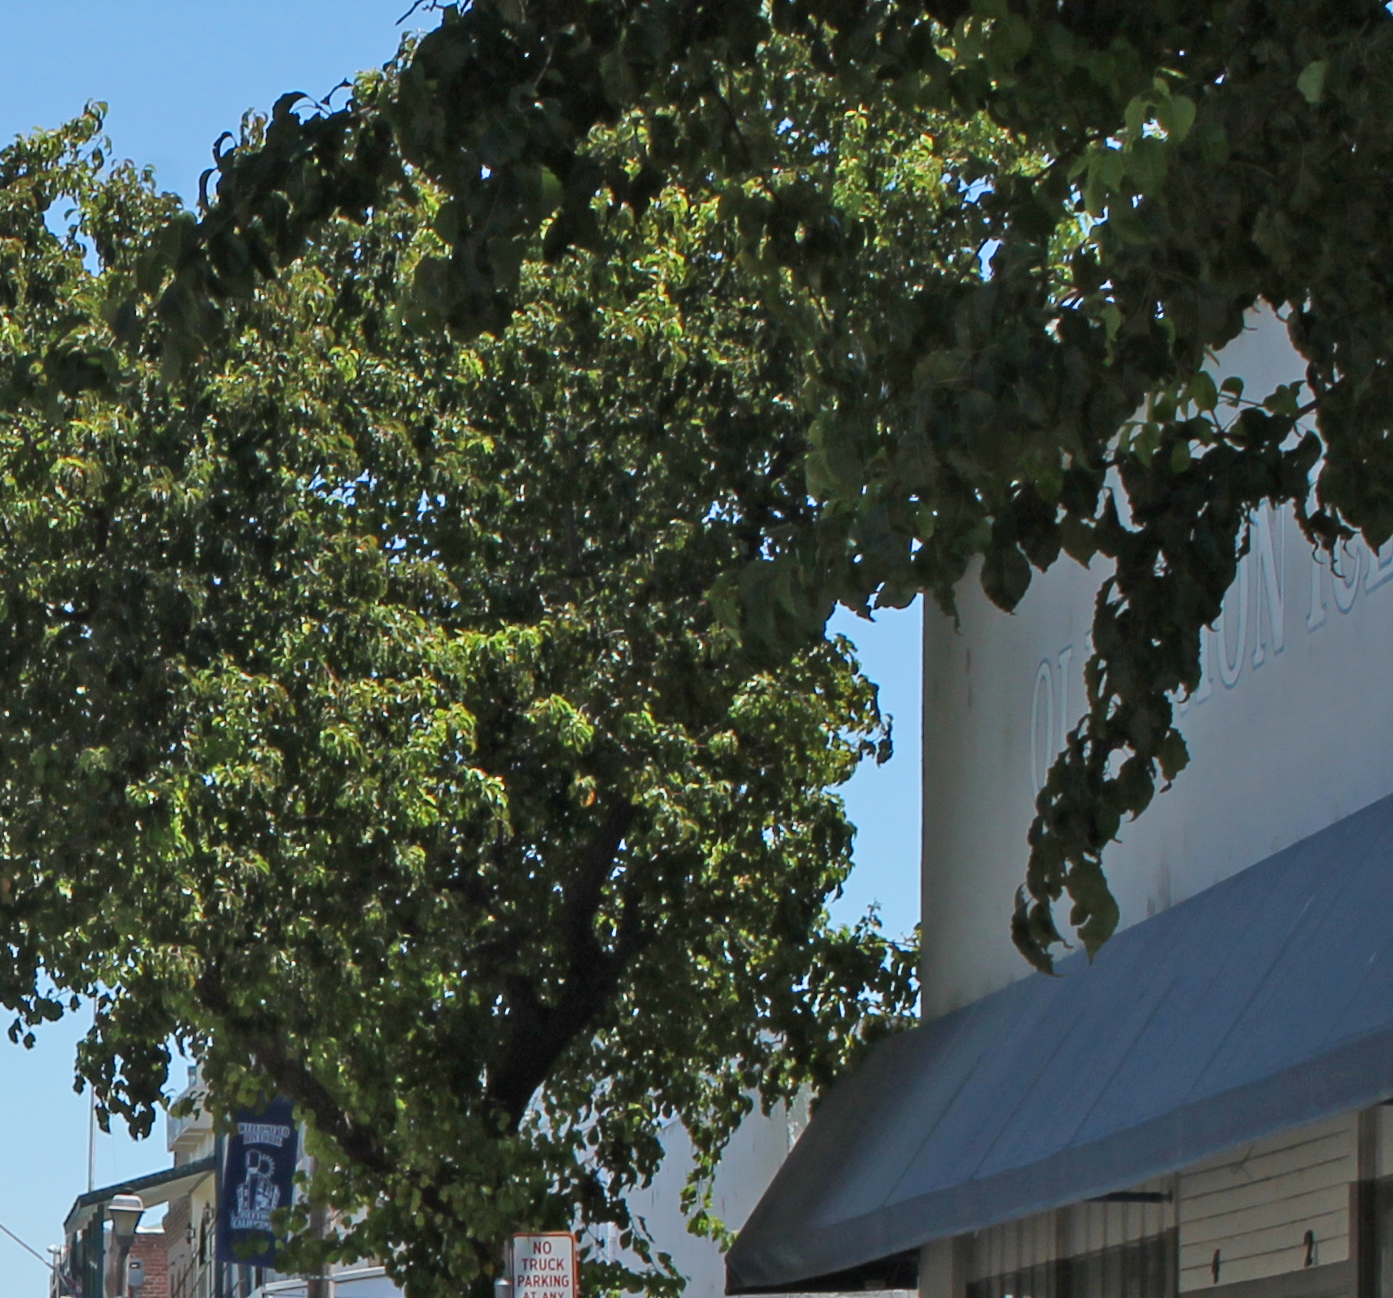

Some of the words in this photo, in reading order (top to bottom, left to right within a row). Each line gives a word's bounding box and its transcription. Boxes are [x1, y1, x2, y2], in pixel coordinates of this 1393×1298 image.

[533, 1241, 552, 1255] NO
[522, 1258, 564, 1271] TRUCK
[517, 1275, 569, 1288] PARKING
